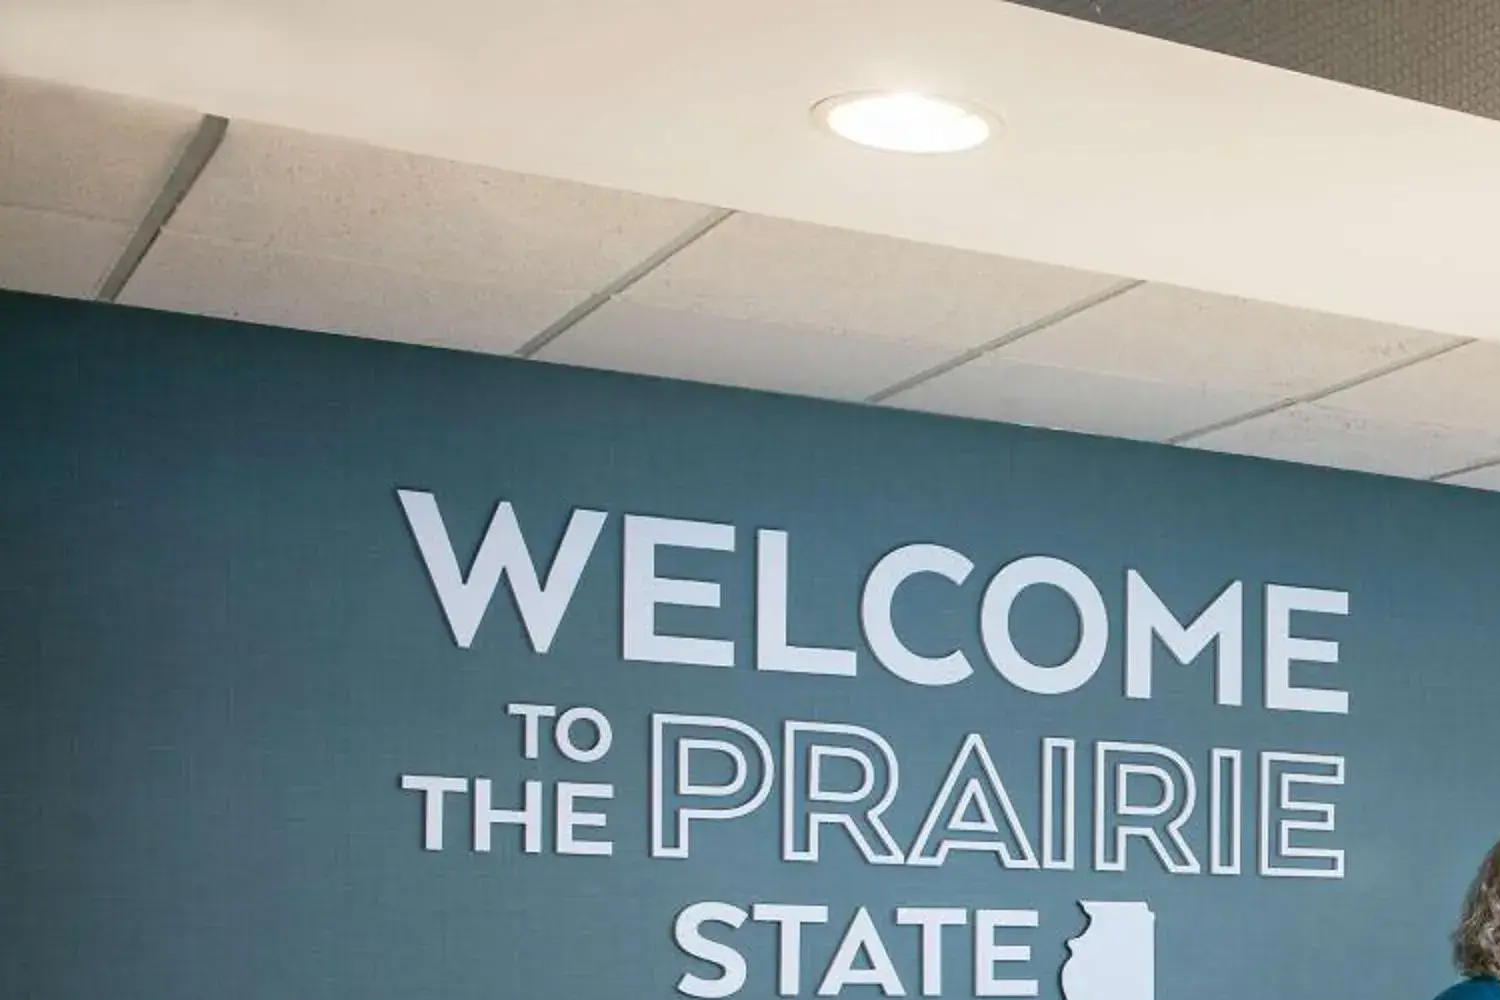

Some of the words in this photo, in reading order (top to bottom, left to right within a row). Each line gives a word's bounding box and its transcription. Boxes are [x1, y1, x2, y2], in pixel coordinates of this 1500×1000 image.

[397, 489, 1350, 715] WELCOME
[400, 773, 616, 857] THE
[650, 712, 1348, 880] PRAIRIE
[507, 702, 614, 763] TO
[674, 900, 1041, 999] STATE
